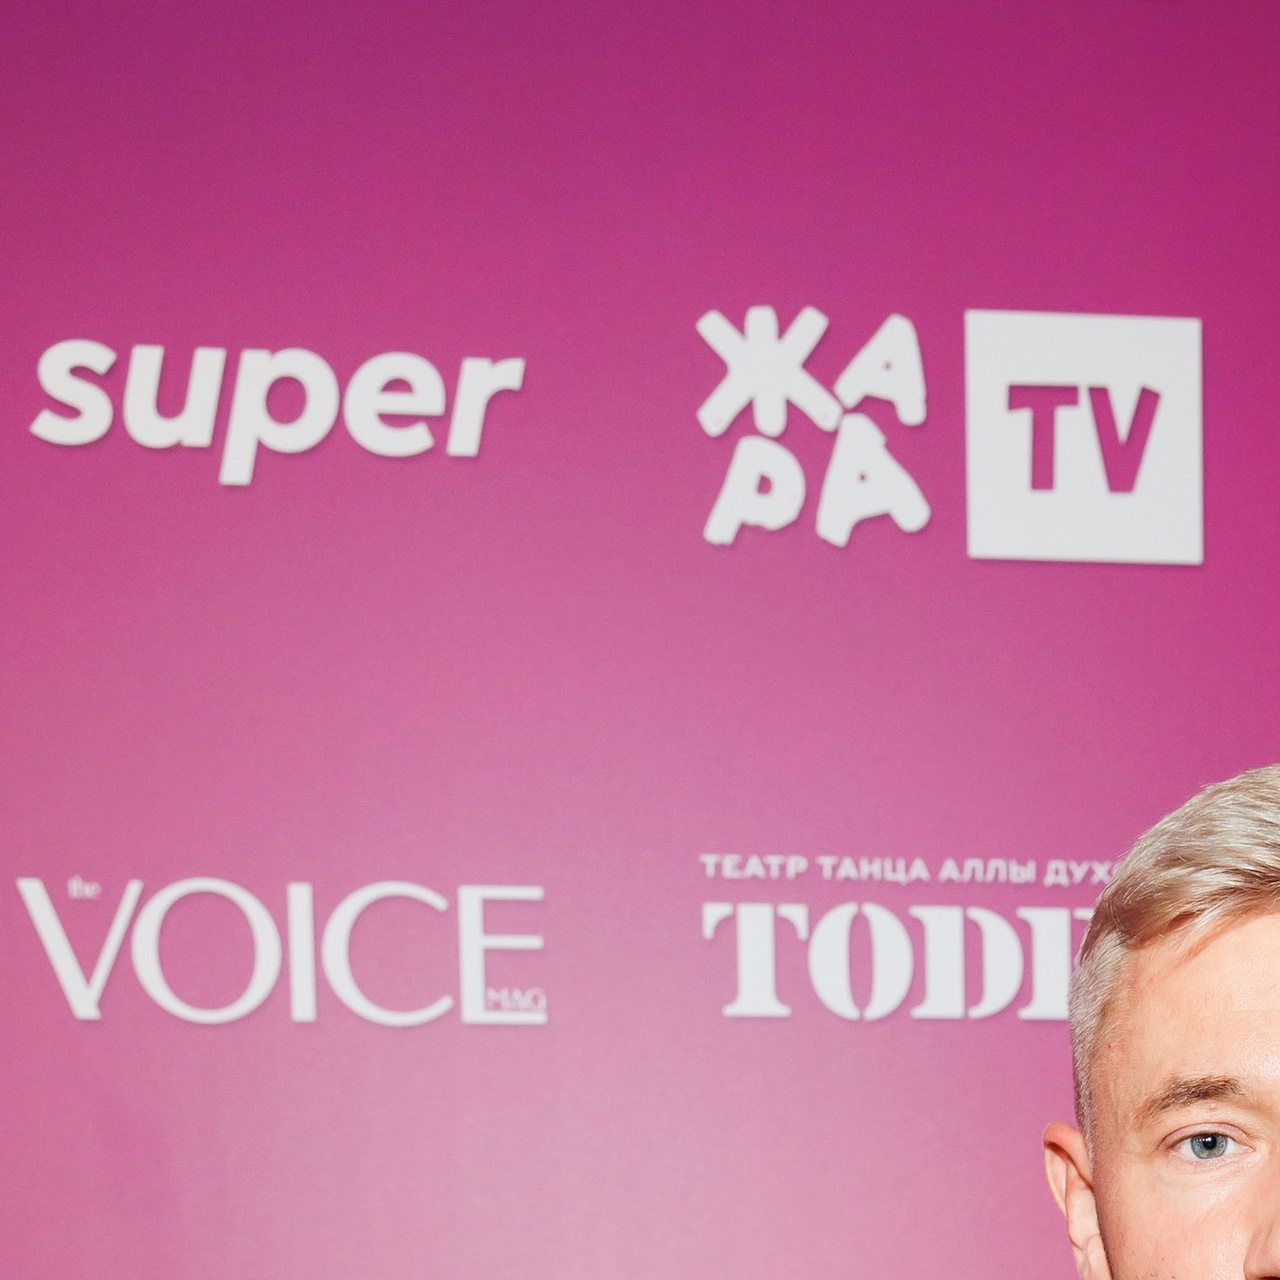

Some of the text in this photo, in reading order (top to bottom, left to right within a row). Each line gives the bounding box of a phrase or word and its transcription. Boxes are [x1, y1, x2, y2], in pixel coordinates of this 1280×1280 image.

[30, 339, 526, 486] super
[1007, 384, 1161, 493] TV
[699, 853, 809, 880] ТЕАТР
[815, 855, 930, 885] ТАНЦА
[938, 857, 1037, 884] АЛЛЫ
[16, 876, 548, 1027] VOICE
